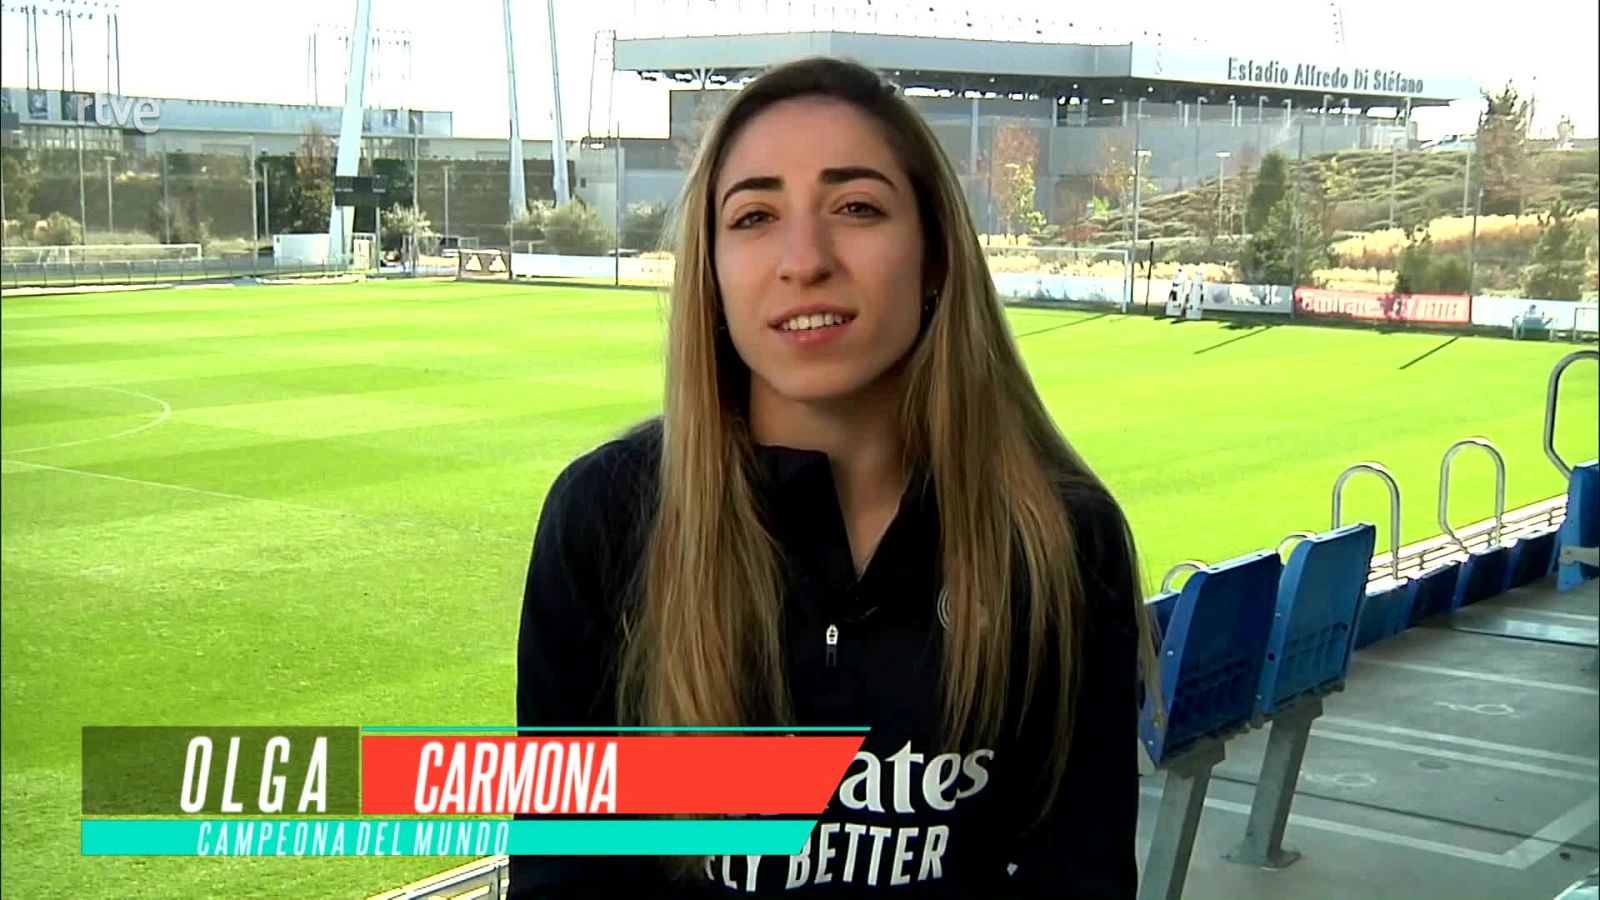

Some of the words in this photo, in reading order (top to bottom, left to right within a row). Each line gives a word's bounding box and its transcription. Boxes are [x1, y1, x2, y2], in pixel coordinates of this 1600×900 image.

[1228, 56, 1289, 84] Estadio
[1294, 63, 1348, 89] Alfredo
[1353, 68, 1369, 91] Di
[1373, 69, 1424, 94] Stéfano
[838, 740, 994, 814] ates
[785, 822, 950, 890] BETTER
